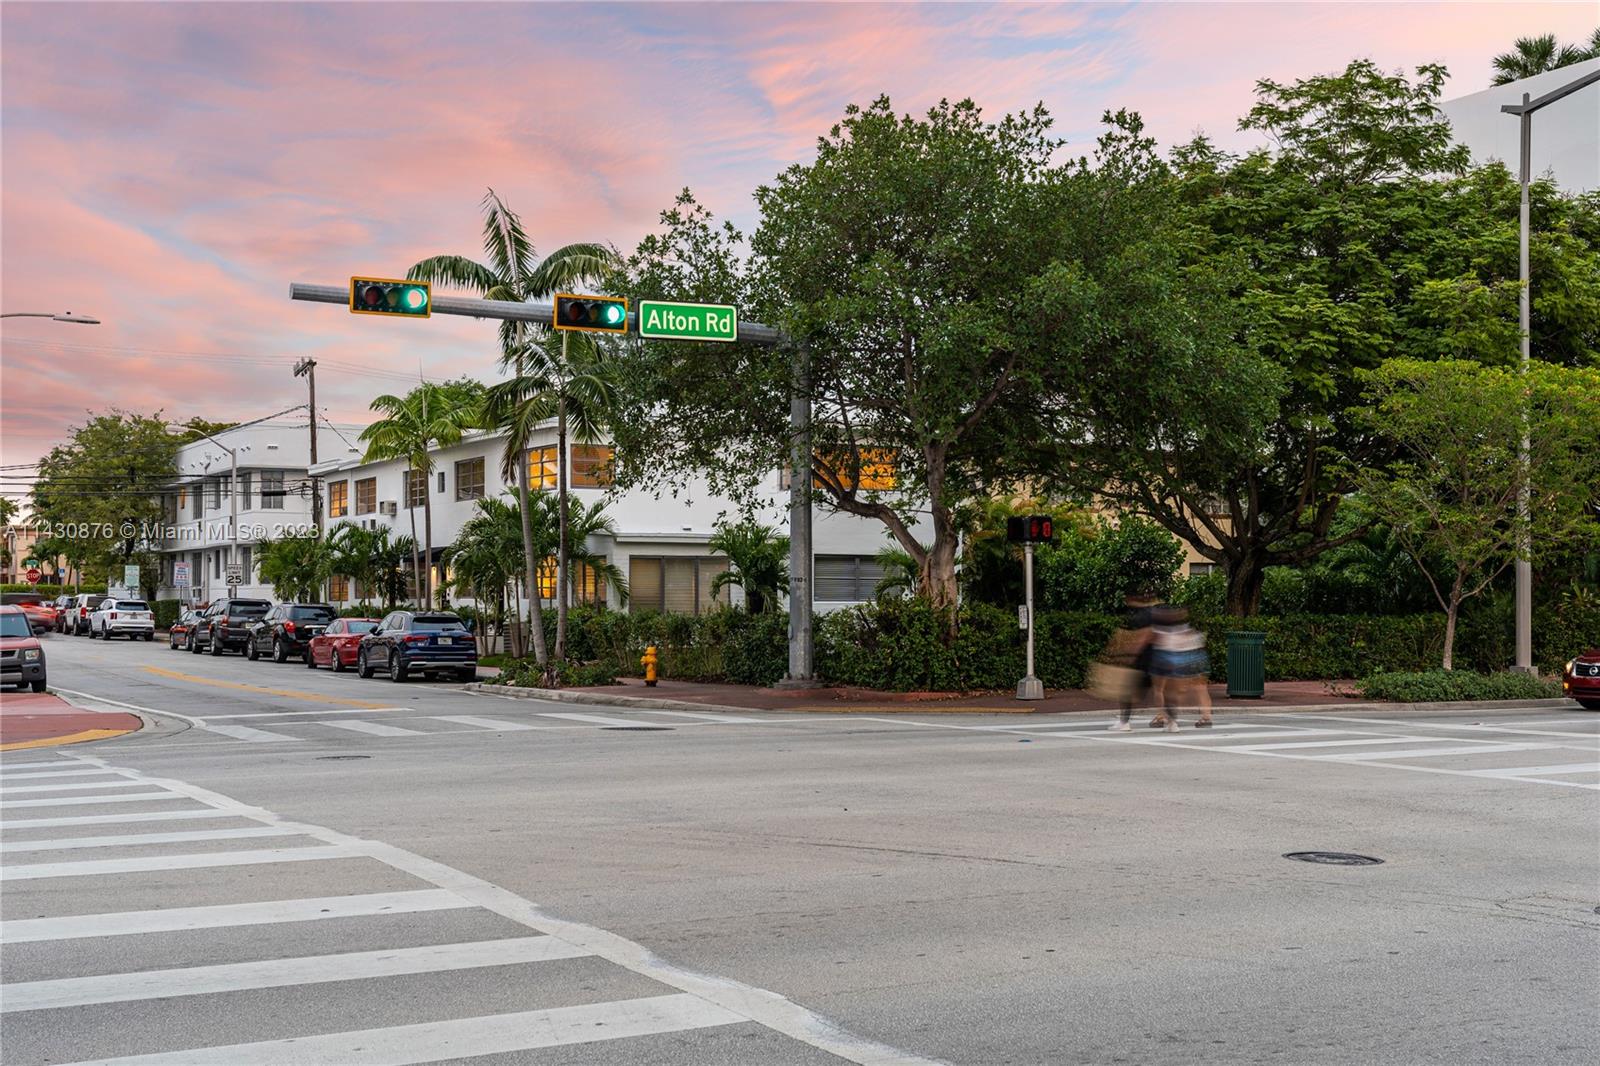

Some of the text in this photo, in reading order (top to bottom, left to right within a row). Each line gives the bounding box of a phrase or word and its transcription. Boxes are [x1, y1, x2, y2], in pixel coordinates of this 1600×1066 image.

[646, 309, 730, 333] Alton Rd
[227, 575, 242, 584] 25
